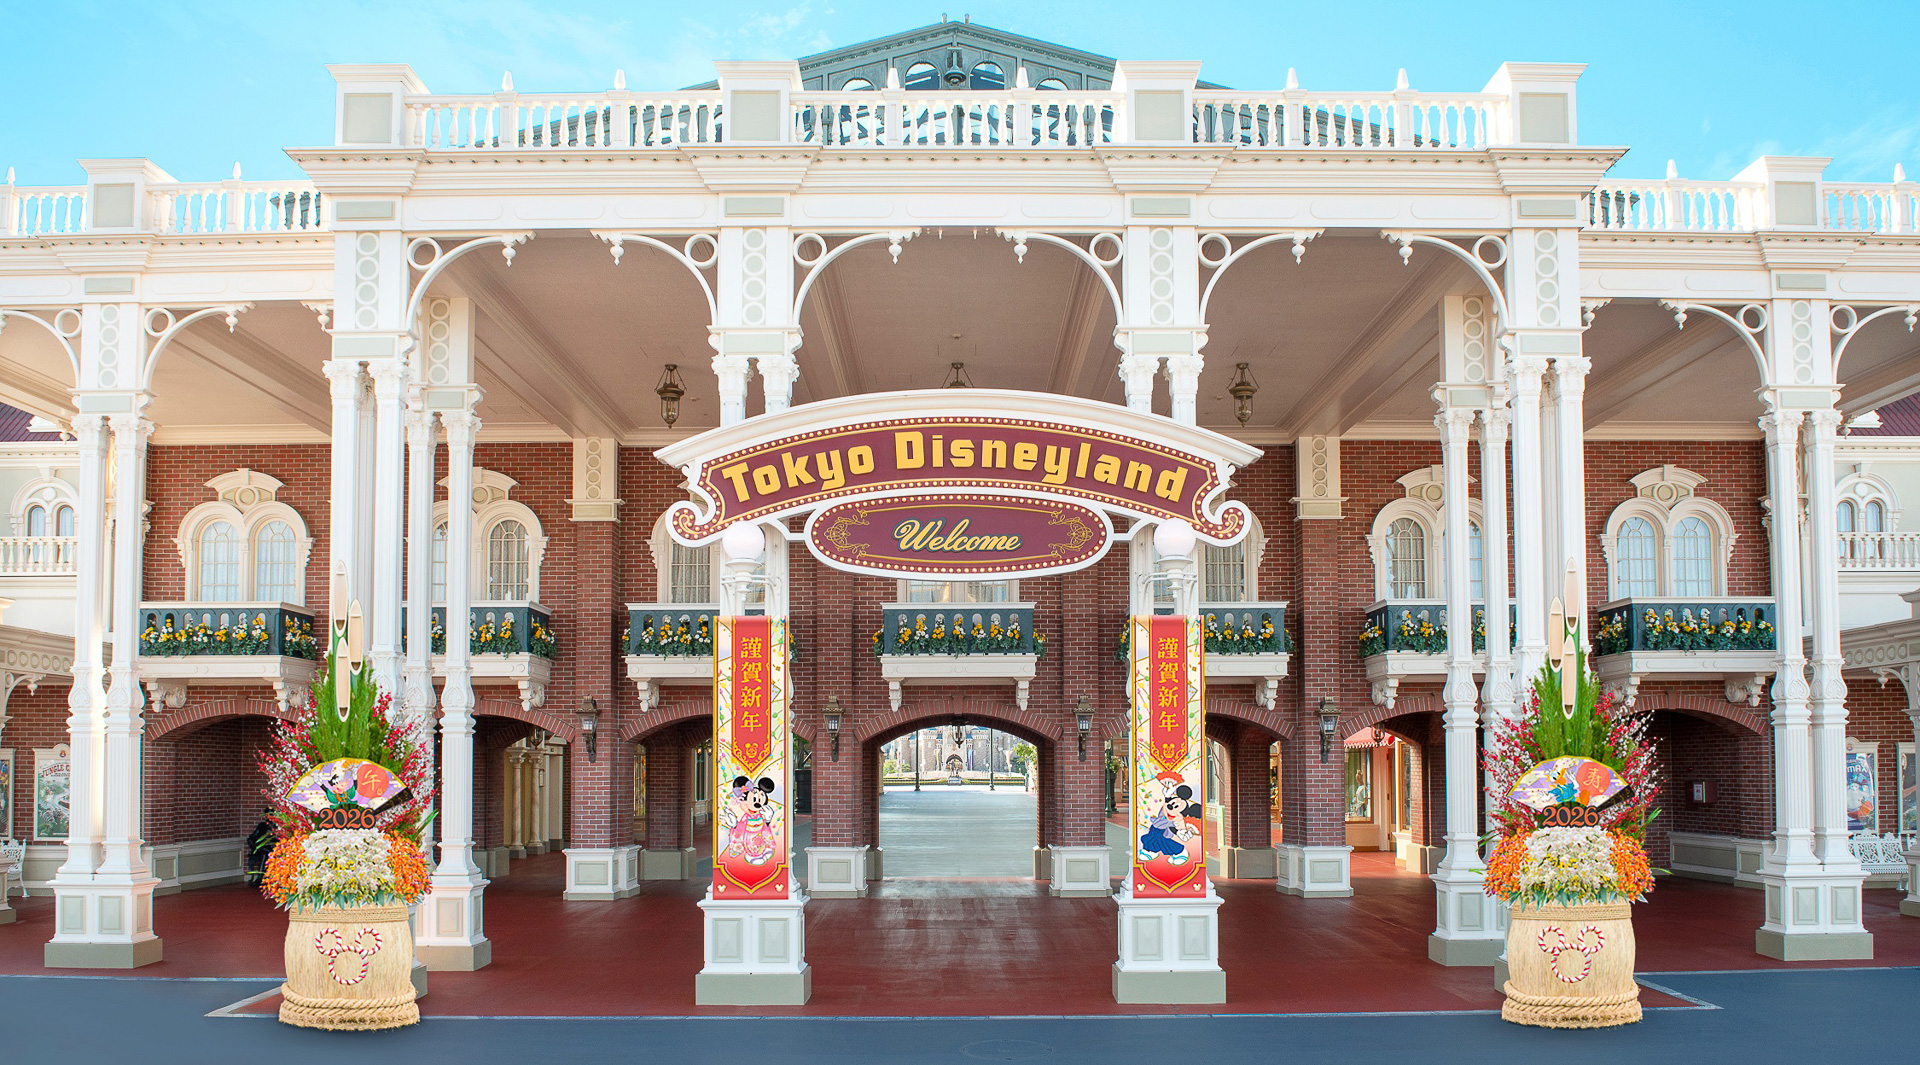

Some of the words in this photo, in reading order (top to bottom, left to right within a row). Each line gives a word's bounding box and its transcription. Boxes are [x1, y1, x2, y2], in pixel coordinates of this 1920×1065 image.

[721, 445, 875, 503] Tokyo
[895, 431, 1189, 503] Disneyland
[893, 518, 1022, 552] Welcome
[740, 636, 762, 732] 謹賀新年
[1157, 637, 1179, 732] 謹賀新年
[41, 764, 65, 777] JUNGLE
[361, 769, 380, 791] 午
[1583, 767, 1602, 789] 寿
[319, 808, 375, 829] 2026
[1542, 806, 1598, 827] 2026
